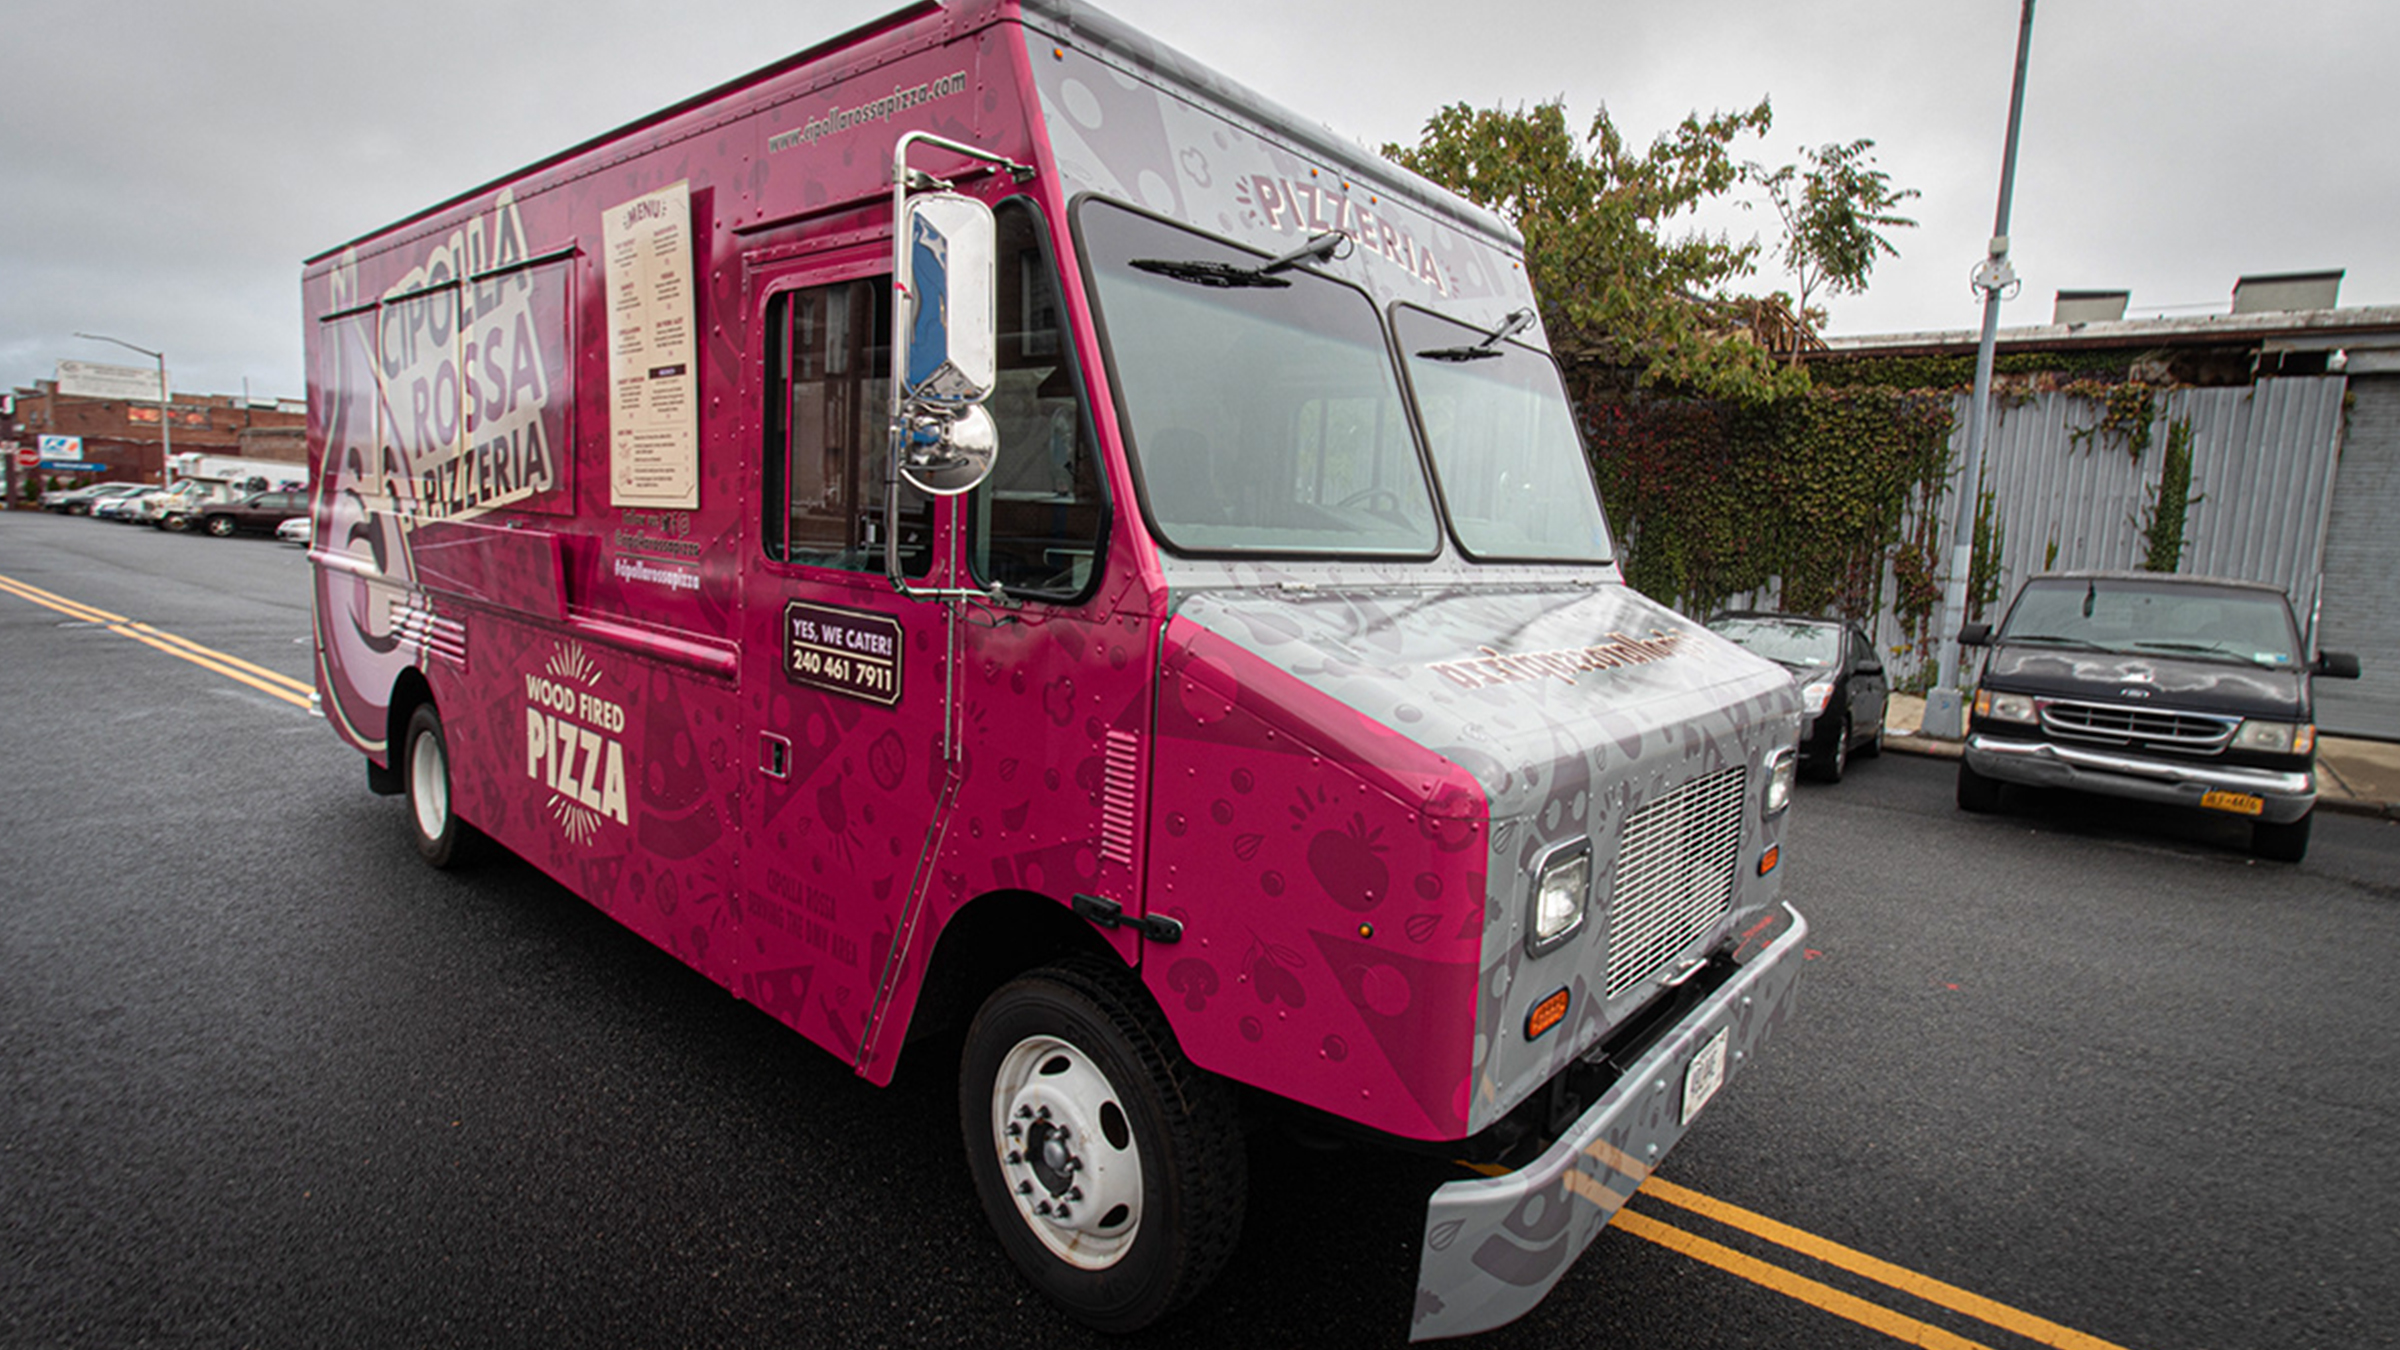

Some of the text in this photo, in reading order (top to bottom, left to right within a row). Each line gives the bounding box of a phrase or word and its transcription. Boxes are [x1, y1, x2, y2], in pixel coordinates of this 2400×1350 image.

[768, 71, 966, 153] www.cipollarossapizza.com
[627, 199, 662, 224] MENU
[1251, 174, 1447, 297] PIZZERIA
[380, 200, 528, 380] CIPOLLA
[412, 312, 543, 459] ROSSA
[422, 420, 548, 518] PIZZERIA
[615, 559, 700, 591] #cipollarossapizza
[792, 618, 893, 656] YES, WE CATER!
[793, 648, 892, 691] 240 461 7911
[526, 674, 625, 734] WOOD FIRED
[527, 706, 629, 826] PIZZA
[768, 867, 836, 922] CIPOLLA ROSSA
[786, 909, 803, 940] THE
[831, 932, 858, 969] AREA
